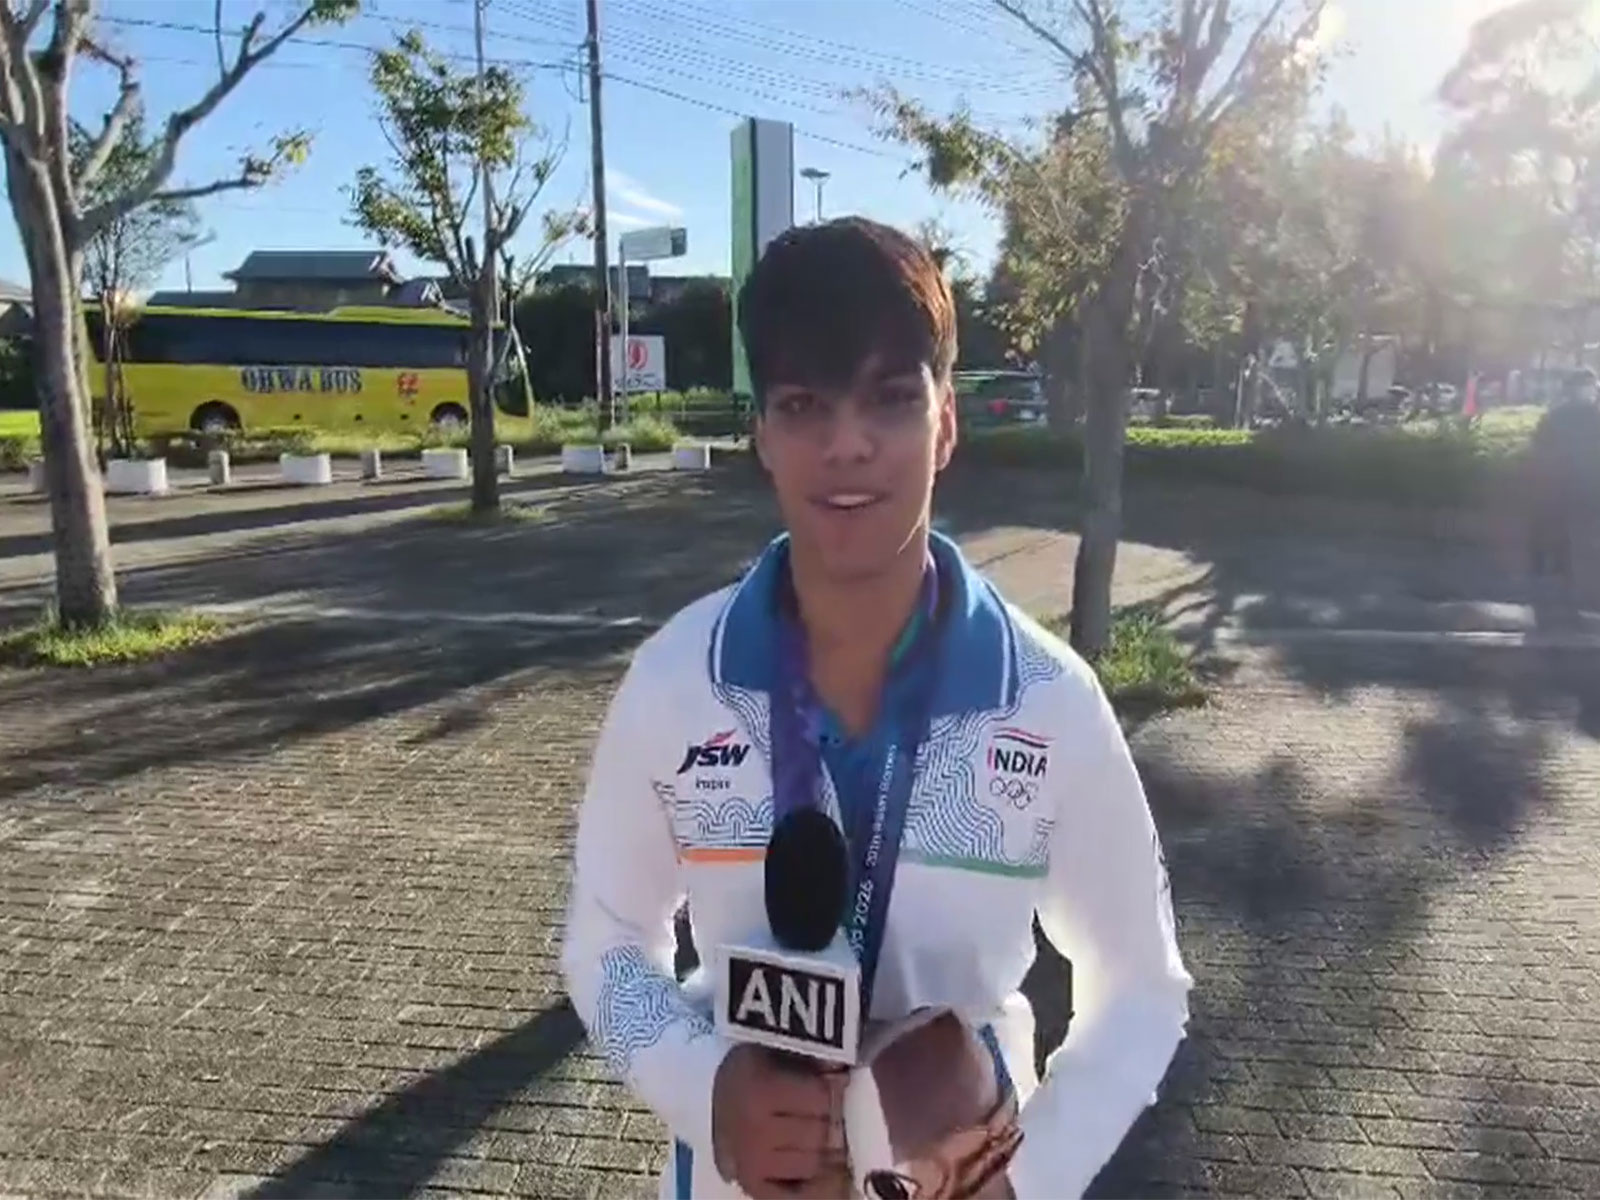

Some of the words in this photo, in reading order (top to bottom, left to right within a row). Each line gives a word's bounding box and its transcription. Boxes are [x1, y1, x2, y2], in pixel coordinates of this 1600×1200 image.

[320, 366, 362, 394] BUS
[676, 743, 751, 775] JSW
[987, 746, 1048, 778] INDIA
[852, 879, 874, 926] 2026
[735, 967, 837, 1041] ANI
